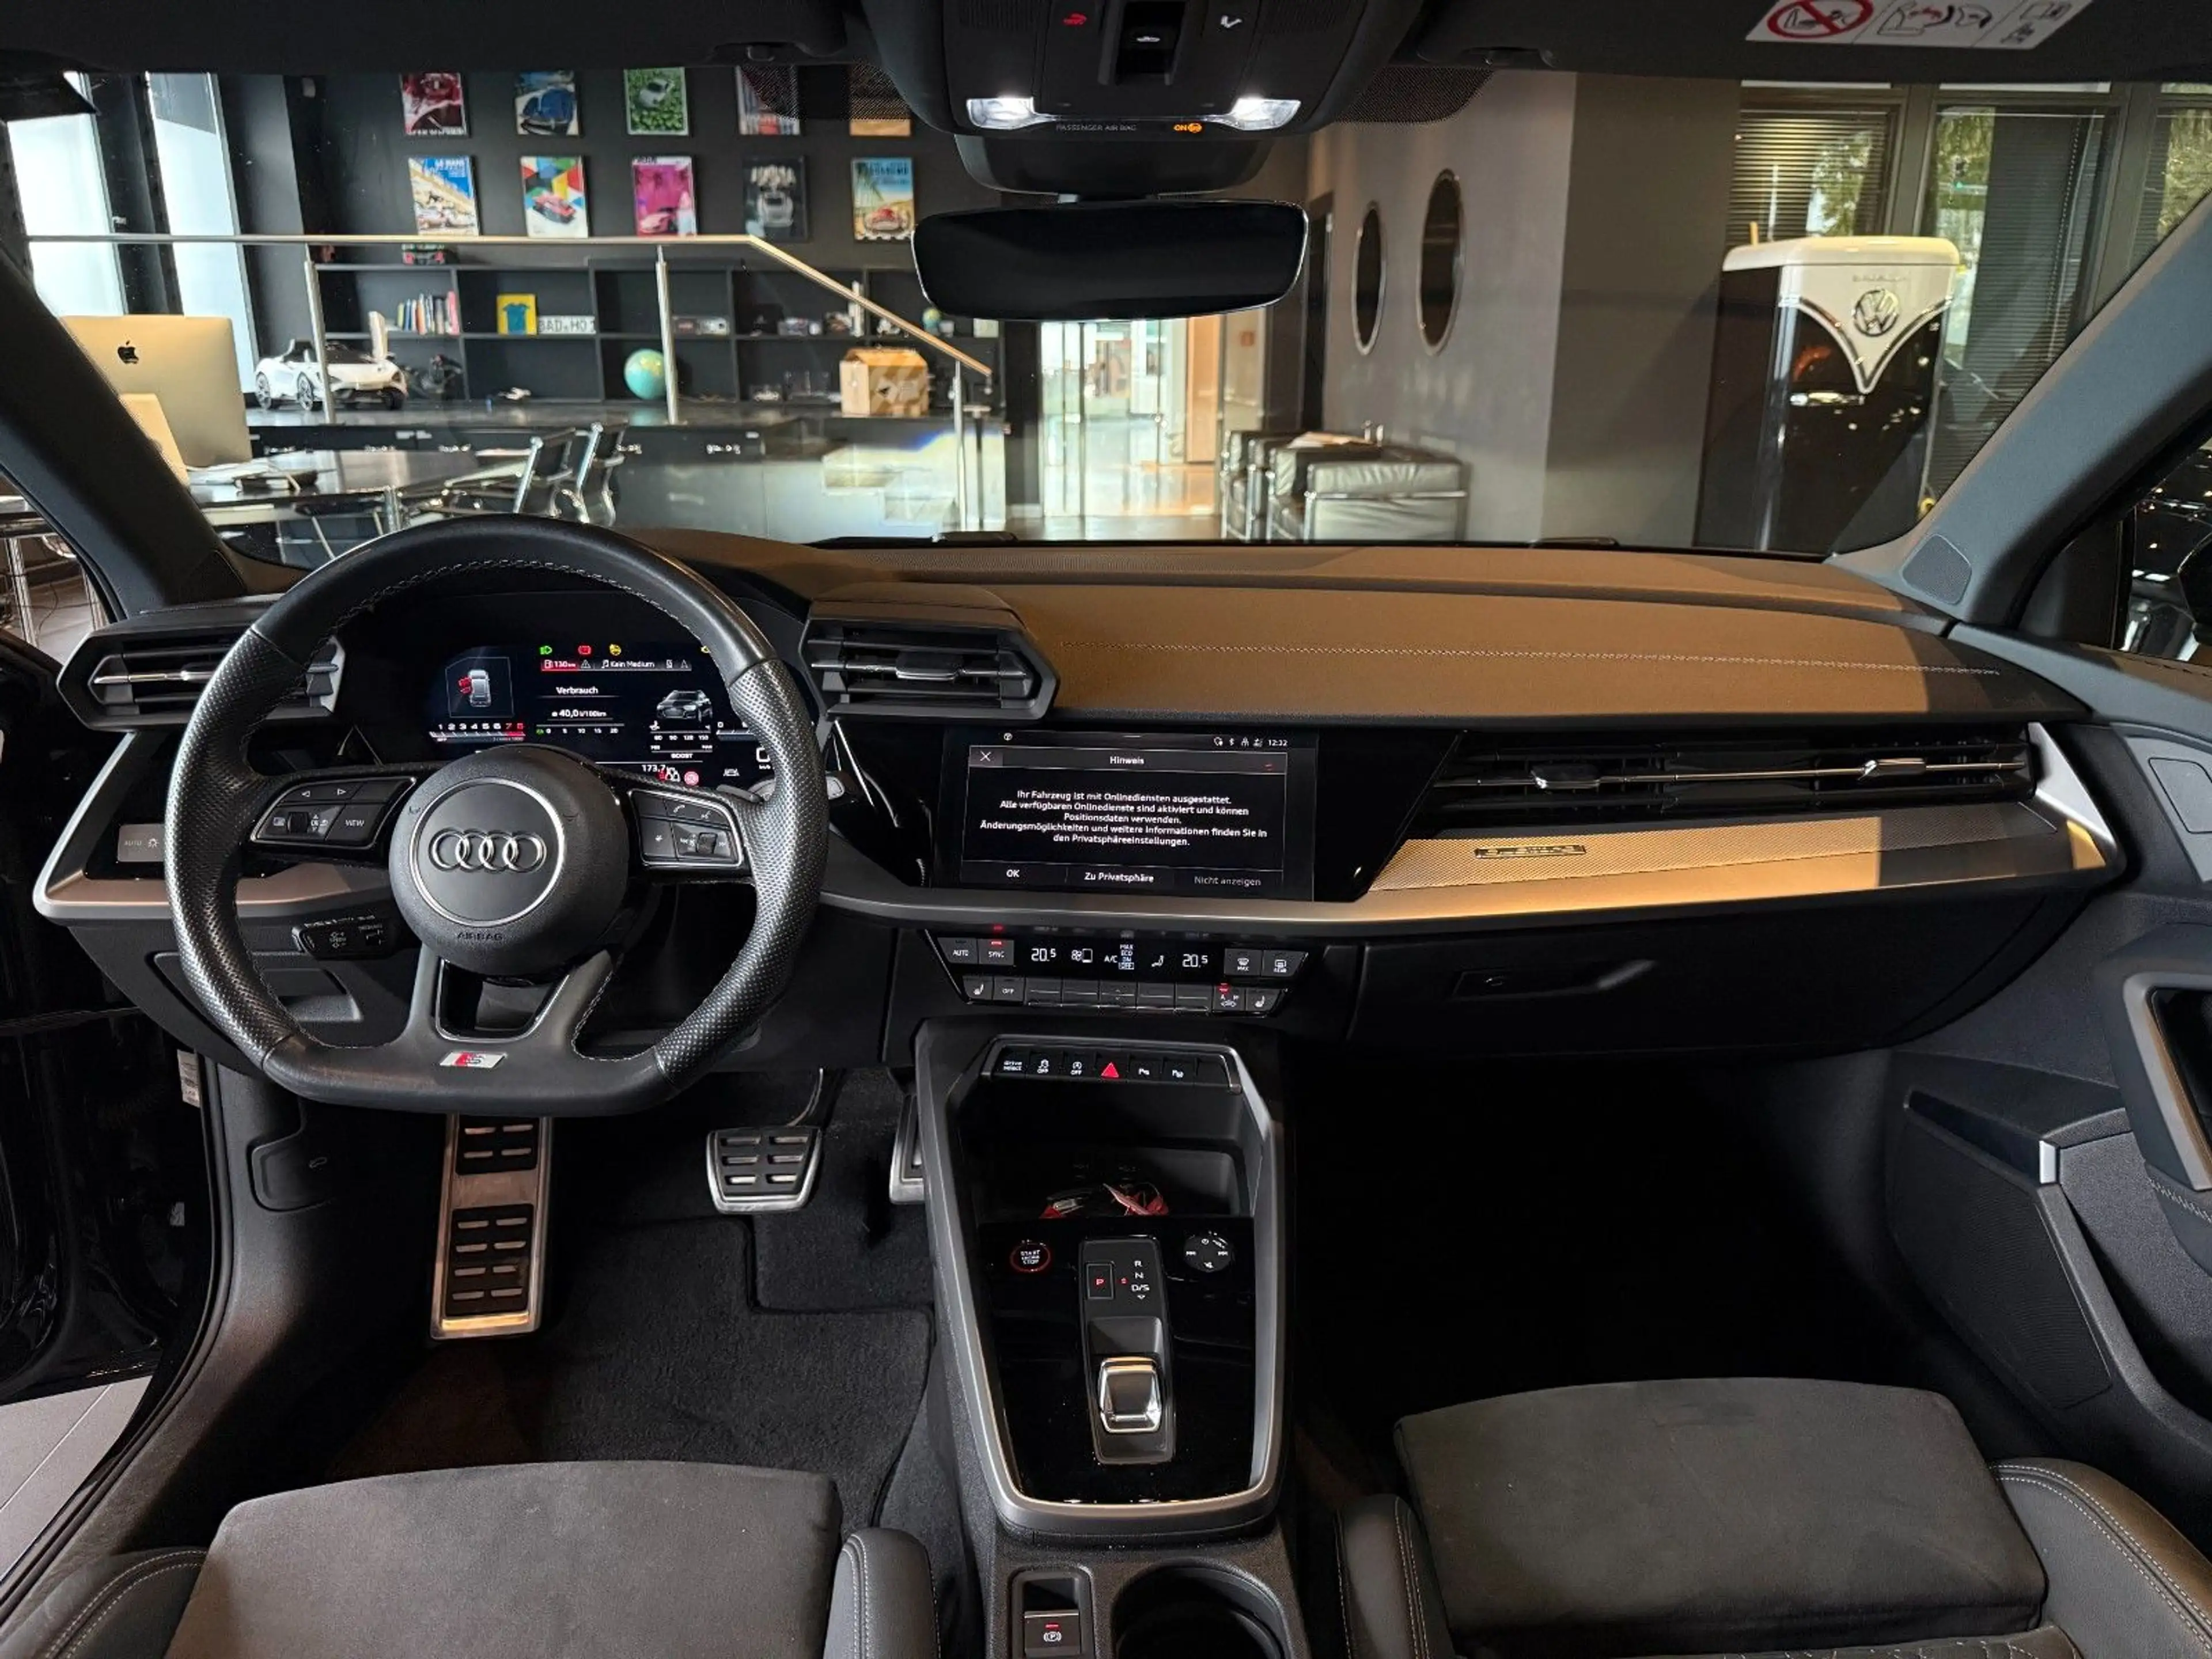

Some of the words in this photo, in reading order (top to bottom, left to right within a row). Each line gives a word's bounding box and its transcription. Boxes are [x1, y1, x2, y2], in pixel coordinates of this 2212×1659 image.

[556, 687, 599, 695] Verbrauch
[1109, 756, 1144, 765] Hinweis
[1017, 790, 1030, 798] Ihr
[1031, 791, 1071, 801] Fahrzeug
[1074, 791, 1085, 800] ist
[1104, 793, 1171, 802] Onlinediensten
[1172, 796, 1232, 805] ausgestattet.
[999, 800, 1017, 809] Alle
[1019, 801, 1072, 811] verfügbaren
[1074, 803, 1135, 812] Onlinedienste
[1137, 805, 1155, 813] sind
[1157, 805, 1195, 814] aktiviert
[1196, 806, 1213, 815] und
[1215, 806, 1249, 816] können
[1064, 813, 1128, 823] Positionsdaten
[1131, 816, 1181, 824] verwenden.
[980, 820, 1089, 833] Änderungsmöglichkeiten
[1091, 824, 1108, 832] und
[1110, 825, 1143, 834] weitere
[1145, 825, 1210, 835] Informationen
[1211, 828, 1241, 836] finden
[1243, 829, 1256, 838] Sie
[1258, 830, 1267, 838] in
[1053, 834, 1070, 842] den
[1072, 835, 1190, 847] Privatsphäreeinstellungen.
[1006, 869, 1020, 877] OK
[1084, 872, 1096, 880] Zu
[1098, 873, 1154, 884] Privatsphäre
[1194, 876, 1219, 885] Nicht
[1221, 877, 1262, 888] anzeigen
[457, 932, 503, 941] AIRBAG
[1104, 955, 1118, 963] A/C
[1131, 1284, 1150, 1292] D/S
